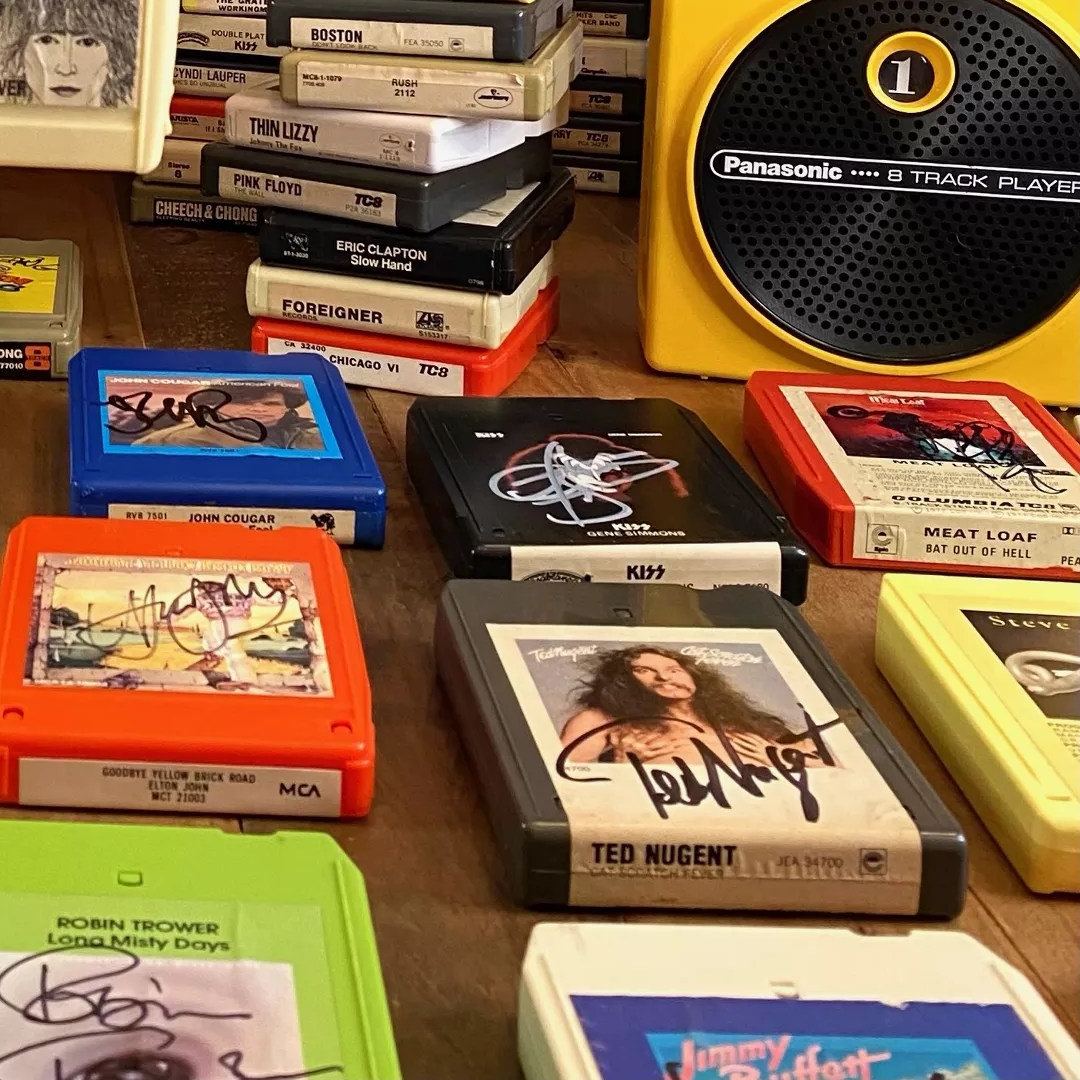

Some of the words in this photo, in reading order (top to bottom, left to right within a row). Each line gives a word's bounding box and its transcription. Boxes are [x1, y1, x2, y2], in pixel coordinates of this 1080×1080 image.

[311, 29, 363, 44] BOSTON
[391, 78, 419, 88] RUSH
[887, 57, 917, 95] 1
[394, 88, 416, 98] 2112
[249, 117, 281, 140] THIN
[281, 120, 319, 145] LIZZY
[724, 155, 843, 181] Panasonic
[233, 174, 262, 193] PINK
[265, 177, 302, 197] FLOYD
[887, 169, 903, 183] 8
[910, 171, 988, 189] TRACK
[336, 239, 363, 253] ERIC
[365, 243, 428, 262] CLAPTON
[350, 254, 378, 269] Slow
[381, 257, 412, 273] Hand
[282, 299, 383, 326] FOREIGNER
[329, 355, 382, 373] CHICAGO
[387, 361, 400, 374] VI
[418, 362, 449, 379] TC8
[188, 512, 220, 524] JOHN
[223, 513, 276, 525] COUGAR
[924, 526, 980, 539] MEAT
[986, 530, 1038, 543] LOAF
[926, 544, 948, 554] BAT
[953, 545, 975, 555] OUT
[982, 547, 997, 556] OF
[1003, 548, 1032, 559] HELL
[626, 565, 666, 580] KISS
[592, 843, 635, 865] TED
[645, 844, 737, 866] NUGENT
[57, 917, 125, 931] ROBIN
[133, 919, 219, 935] TROWER
